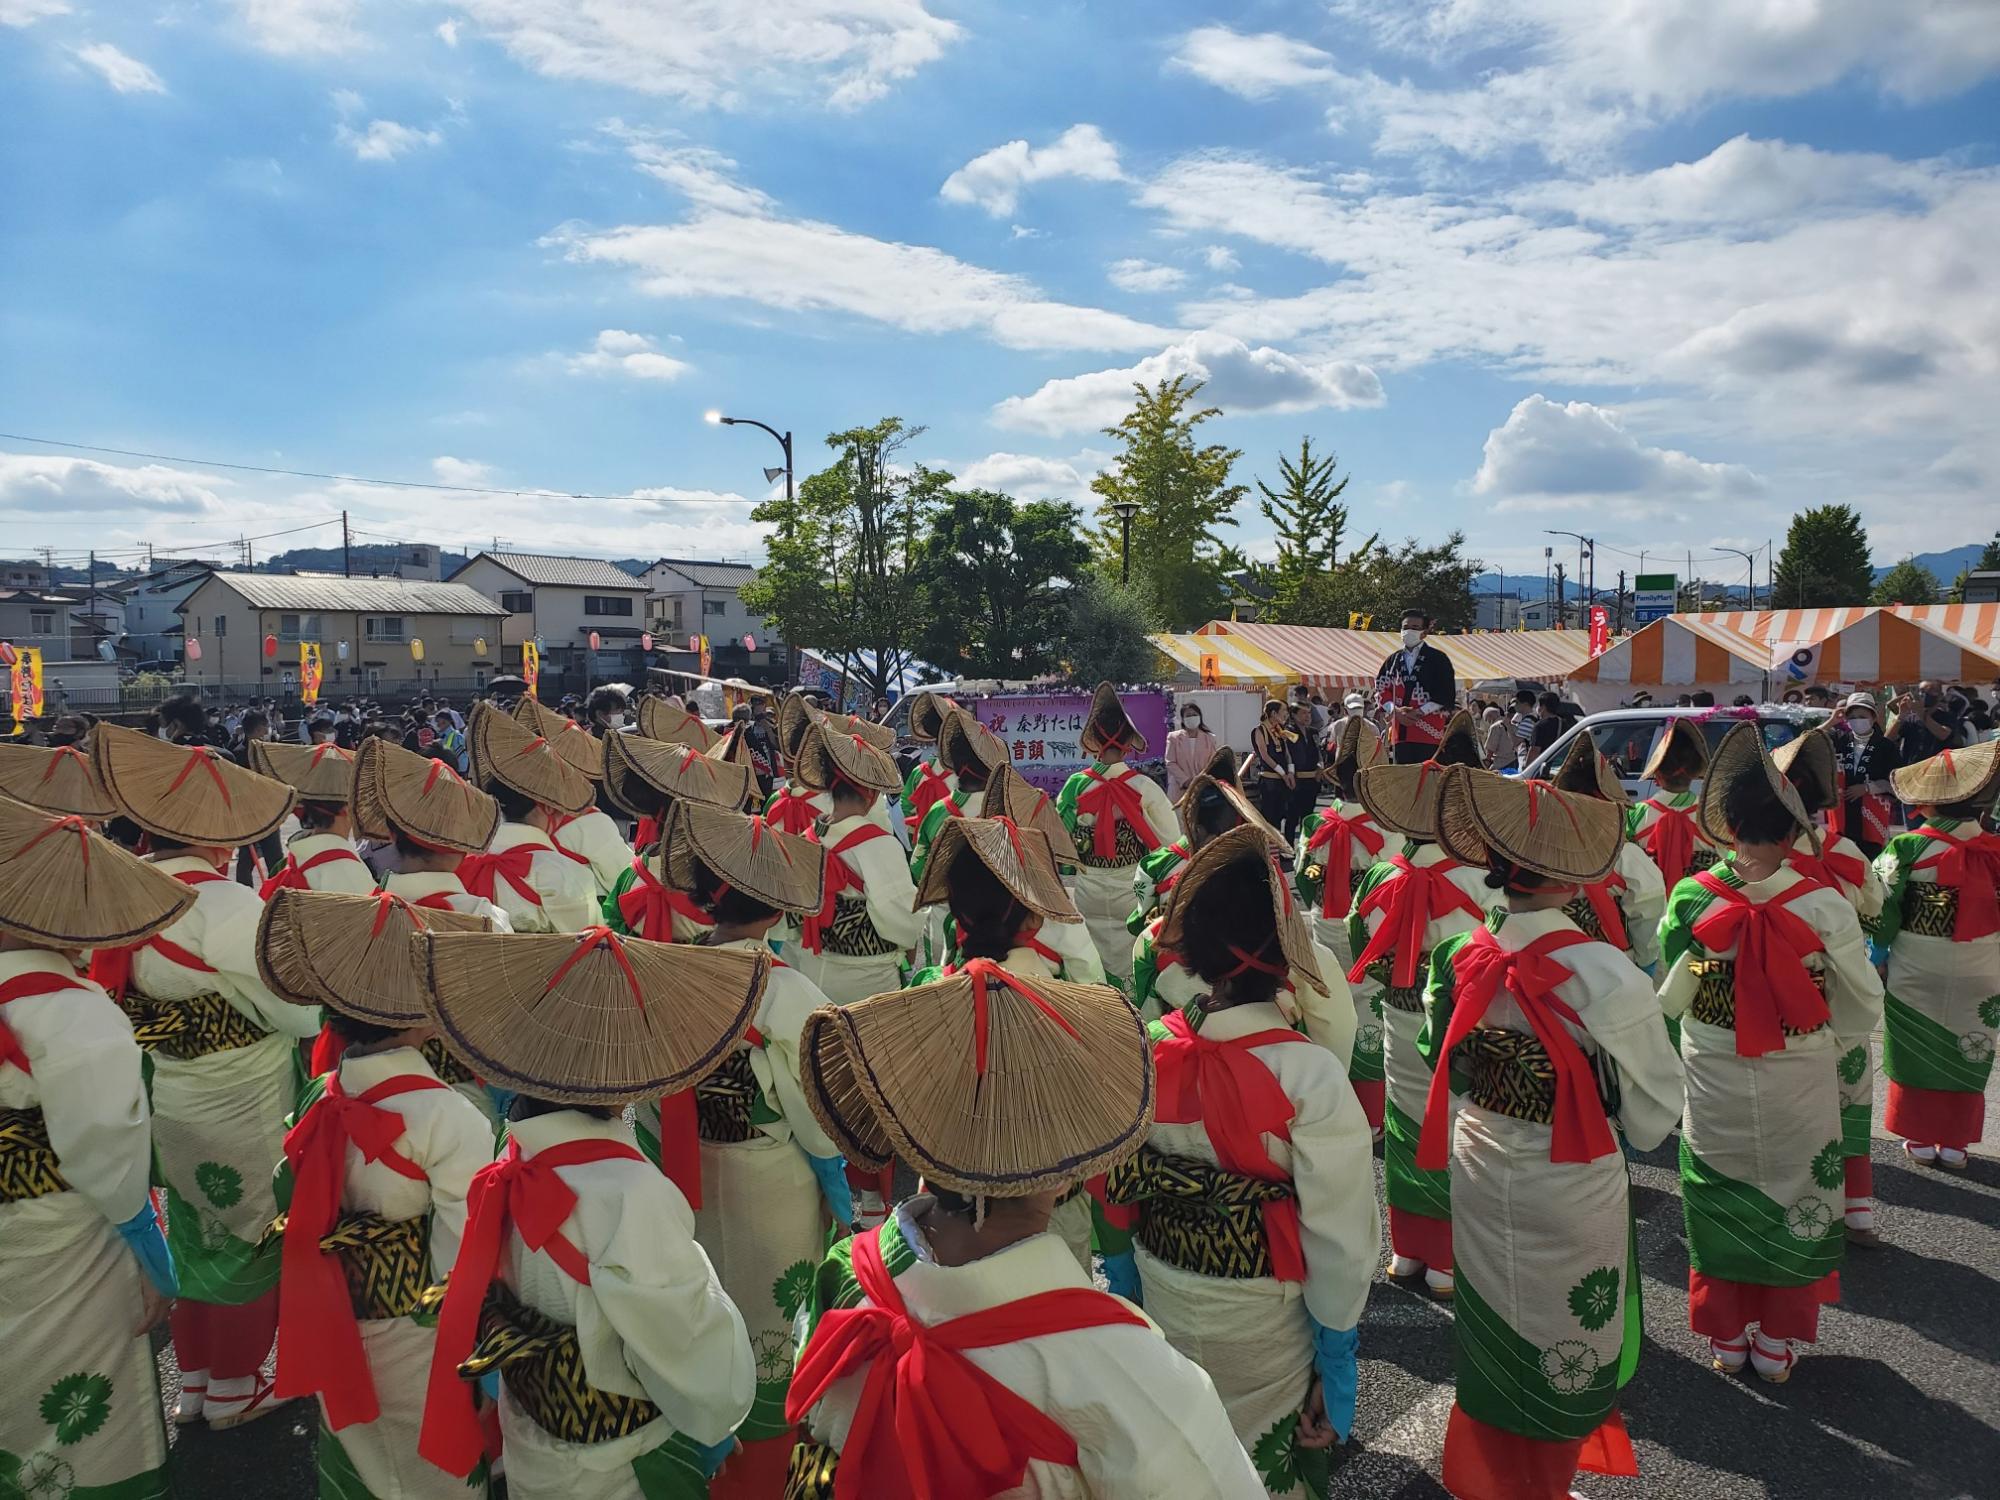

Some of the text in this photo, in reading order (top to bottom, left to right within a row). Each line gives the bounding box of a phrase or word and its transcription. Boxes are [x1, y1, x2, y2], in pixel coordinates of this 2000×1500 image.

[1636, 594, 1672, 603] FamilyMart
[989, 712, 1008, 733] 祝
[1011, 738, 1045, 761] 音頭
